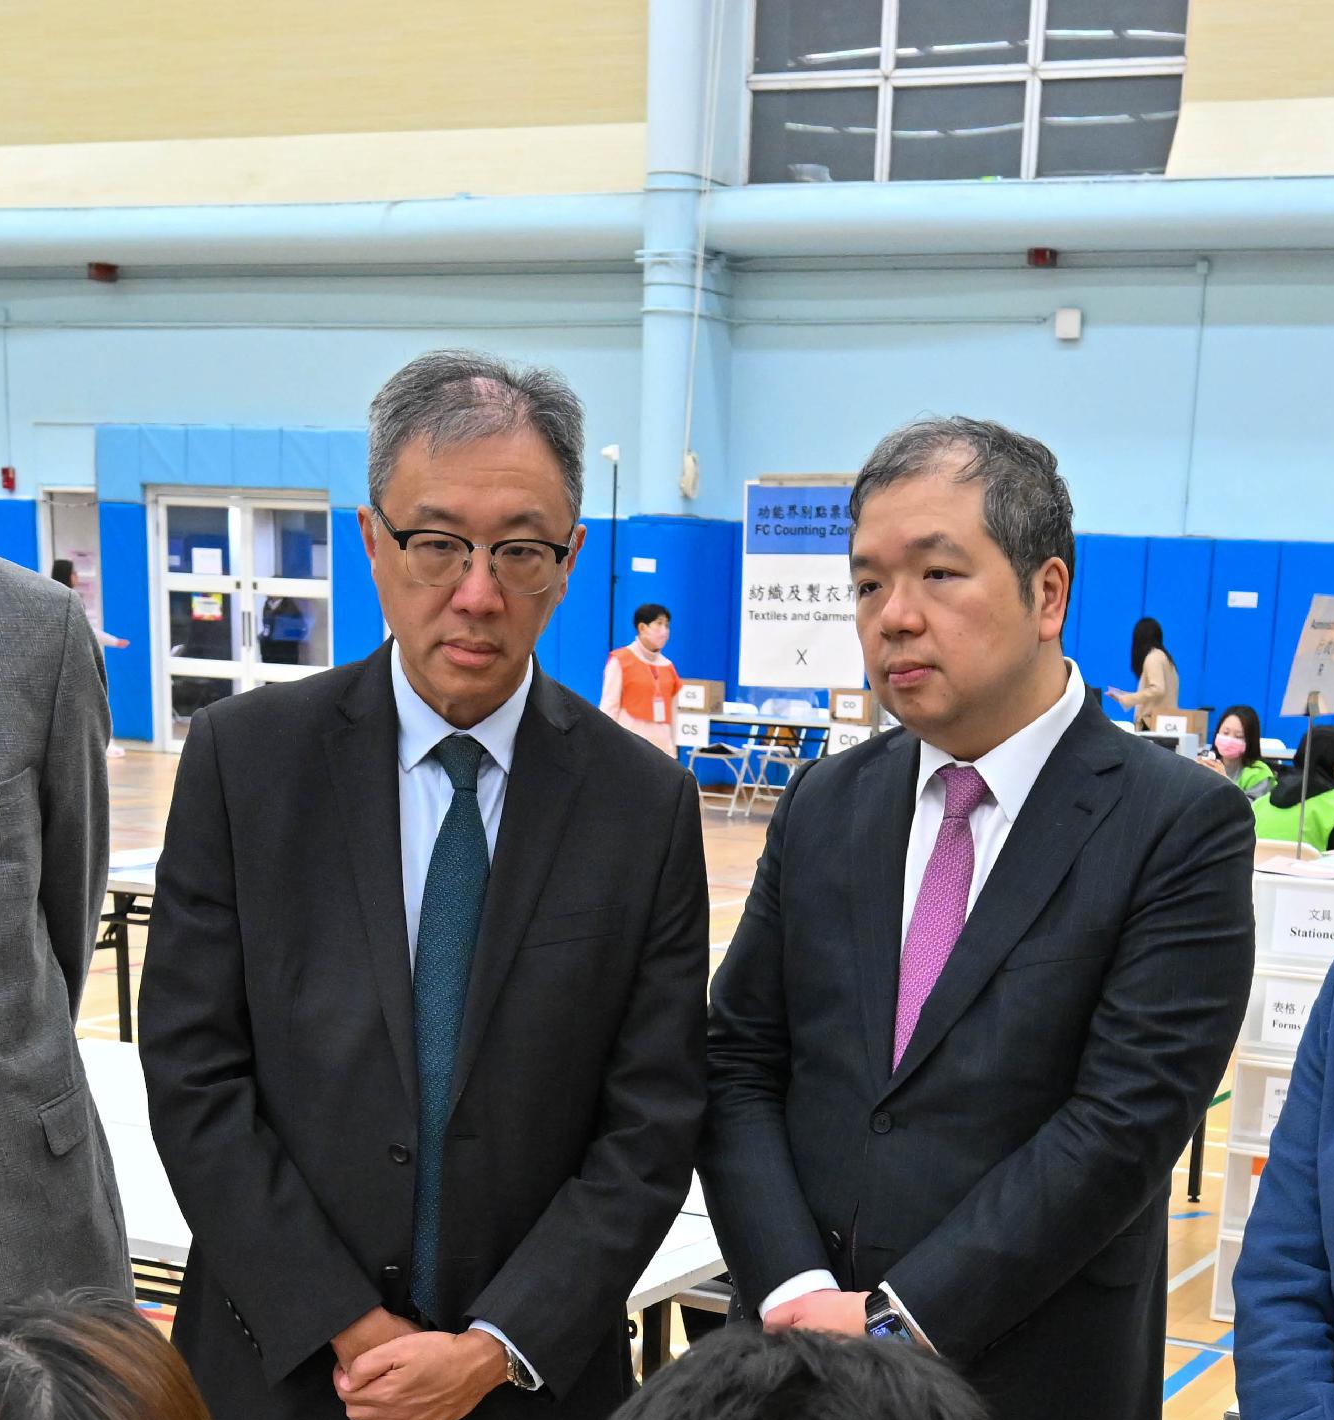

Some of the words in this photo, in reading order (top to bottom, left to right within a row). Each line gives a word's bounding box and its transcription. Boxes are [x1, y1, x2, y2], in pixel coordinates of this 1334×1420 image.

[755, 524, 769, 536] FC
[774, 523, 826, 538] Counting
[749, 610, 788, 622] Textiles
[791, 610, 809, 622] and
[813, 611, 855, 622] Garmen
[796, 649, 808, 665] X
[682, 724, 698, 735] CS
[1308, 909, 1332, 922] 文具
[1272, 1019, 1301, 1030] Forms
